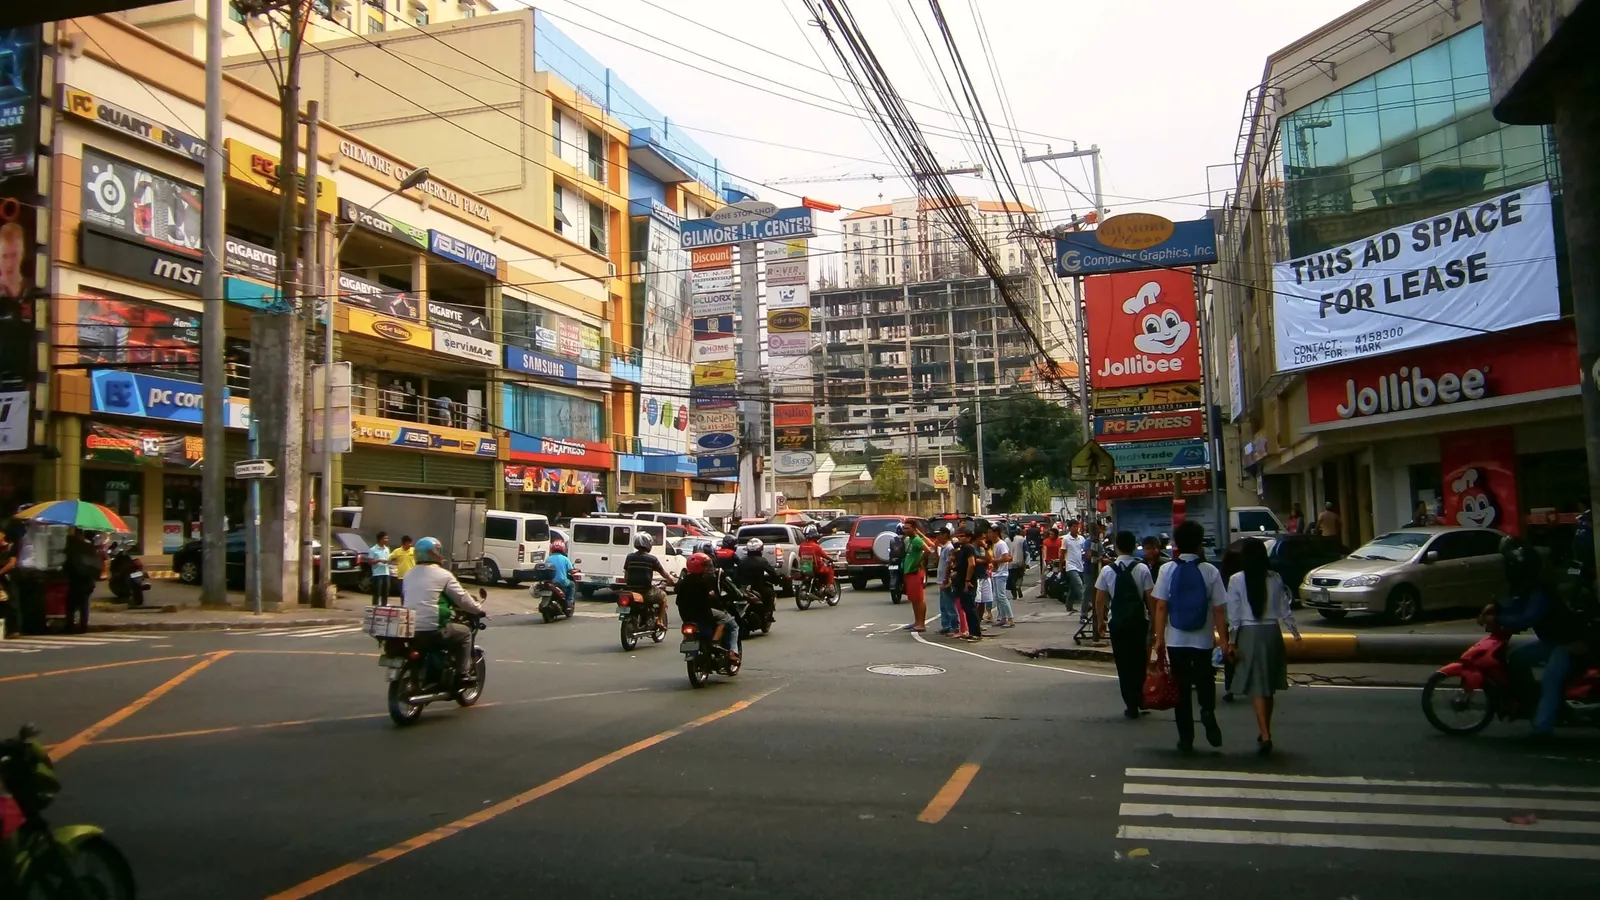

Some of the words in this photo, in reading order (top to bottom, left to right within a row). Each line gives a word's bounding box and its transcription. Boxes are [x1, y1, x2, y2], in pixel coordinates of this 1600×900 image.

[3, 106, 25, 116] HAS
[72, 95, 92, 112] PC
[251, 154, 274, 173] PC
[340, 140, 391, 176] GILMORE
[394, 167, 461, 208] COMERCIAL
[463, 197, 491, 221] PLAZA
[359, 211, 373, 225] PC
[373, 216, 394, 233] CITY
[714, 212, 732, 220] ONE
[733, 209, 754, 218] STOP
[755, 206, 776, 215] SHOP
[682, 225, 739, 247] GILMORE
[742, 220, 763, 240] I.T.
[764, 216, 812, 237] CENTER
[1101, 224, 1166, 236] GILMORE
[1290, 249, 1352, 285] THIS
[1362, 232, 1401, 268] AD
[1412, 193, 1522, 253] SPACE
[226, 241, 277, 267] GIGABYTE
[466, 245, 496, 270] WORLD
[693, 248, 730, 263] Discount
[1083, 252, 1136, 268] Computer
[1139, 246, 1191, 261] Graphics,
[1194, 244, 1214, 256] Inc.
[153, 258, 203, 286] msi
[339, 276, 383, 298] GIGABYTE
[1319, 284, 1375, 318] FOR
[1384, 252, 1488, 304] LEASE
[428, 303, 463, 321] GIGABYTE
[1294, 340, 1342, 355] CONTACT:
[1355, 327, 1403, 343] 4158300
[1294, 353, 1318, 364] LOOK
[1325, 349, 1347, 360] FOR:
[1355, 342, 1382, 354] MARK
[523, 354, 565, 377] SAMSUNG
[1098, 354, 1182, 376] Jollibee
[148, 388, 172, 408] pc
[1336, 366, 1485, 418] Jollibee
[360, 427, 373, 437] PC
[374, 429, 393, 440] CITY
[404, 432, 429, 443] ASUS
[481, 443, 497, 451] ASUS
[1115, 451, 1173, 461] techtrade
[1115, 473, 1147, 484] M.I.P
[1148, 469, 1205, 481] Lapops
[1148, 480, 1207, 488] SERVCES
